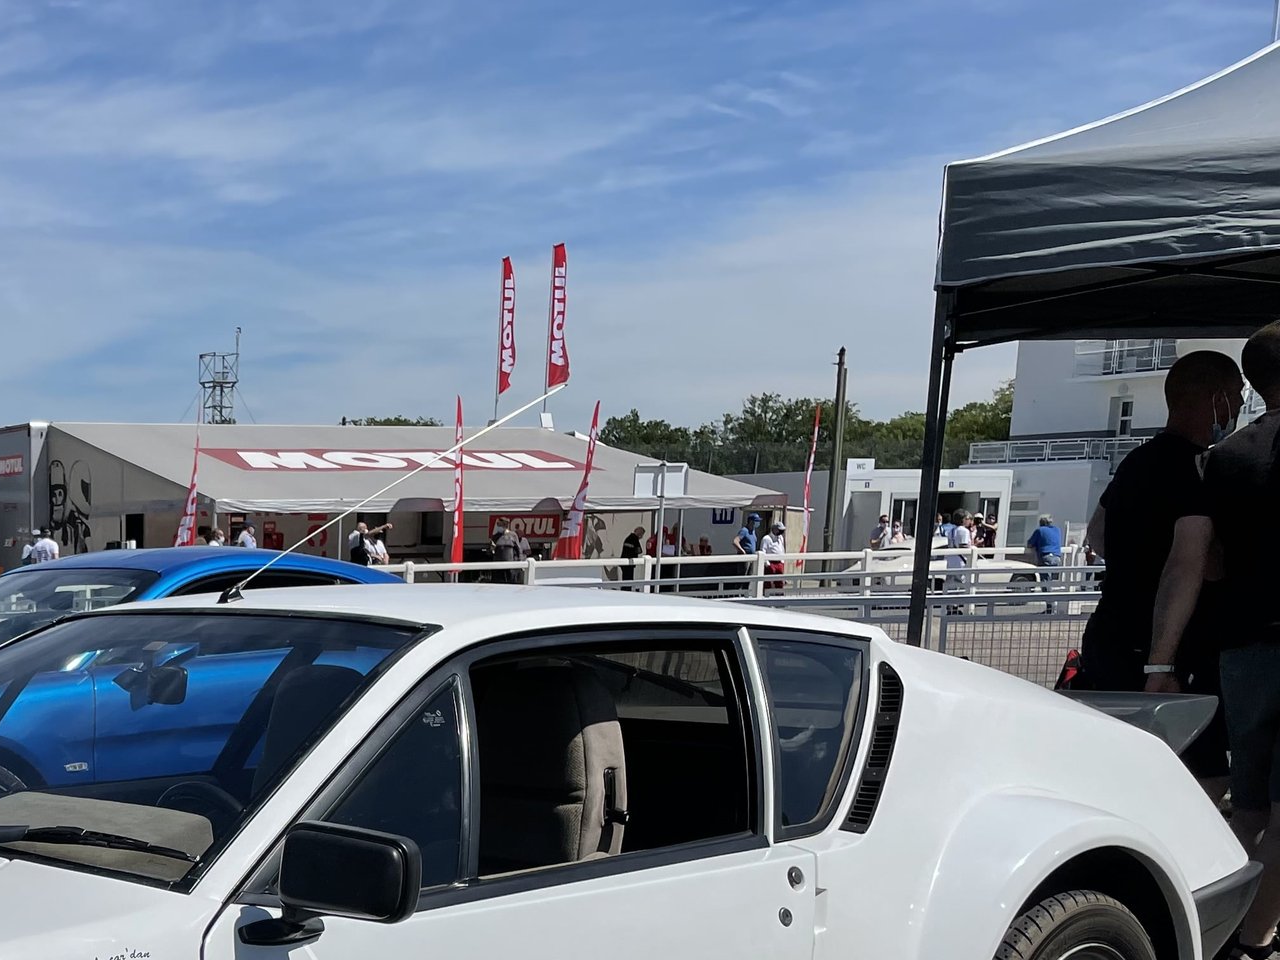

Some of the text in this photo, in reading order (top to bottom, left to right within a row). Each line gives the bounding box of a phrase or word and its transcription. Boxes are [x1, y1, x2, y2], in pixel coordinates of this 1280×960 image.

[501, 273, 515, 374] MOTUL
[551, 261, 566, 367] MOTUL
[236, 451, 576, 470] MOTUL
